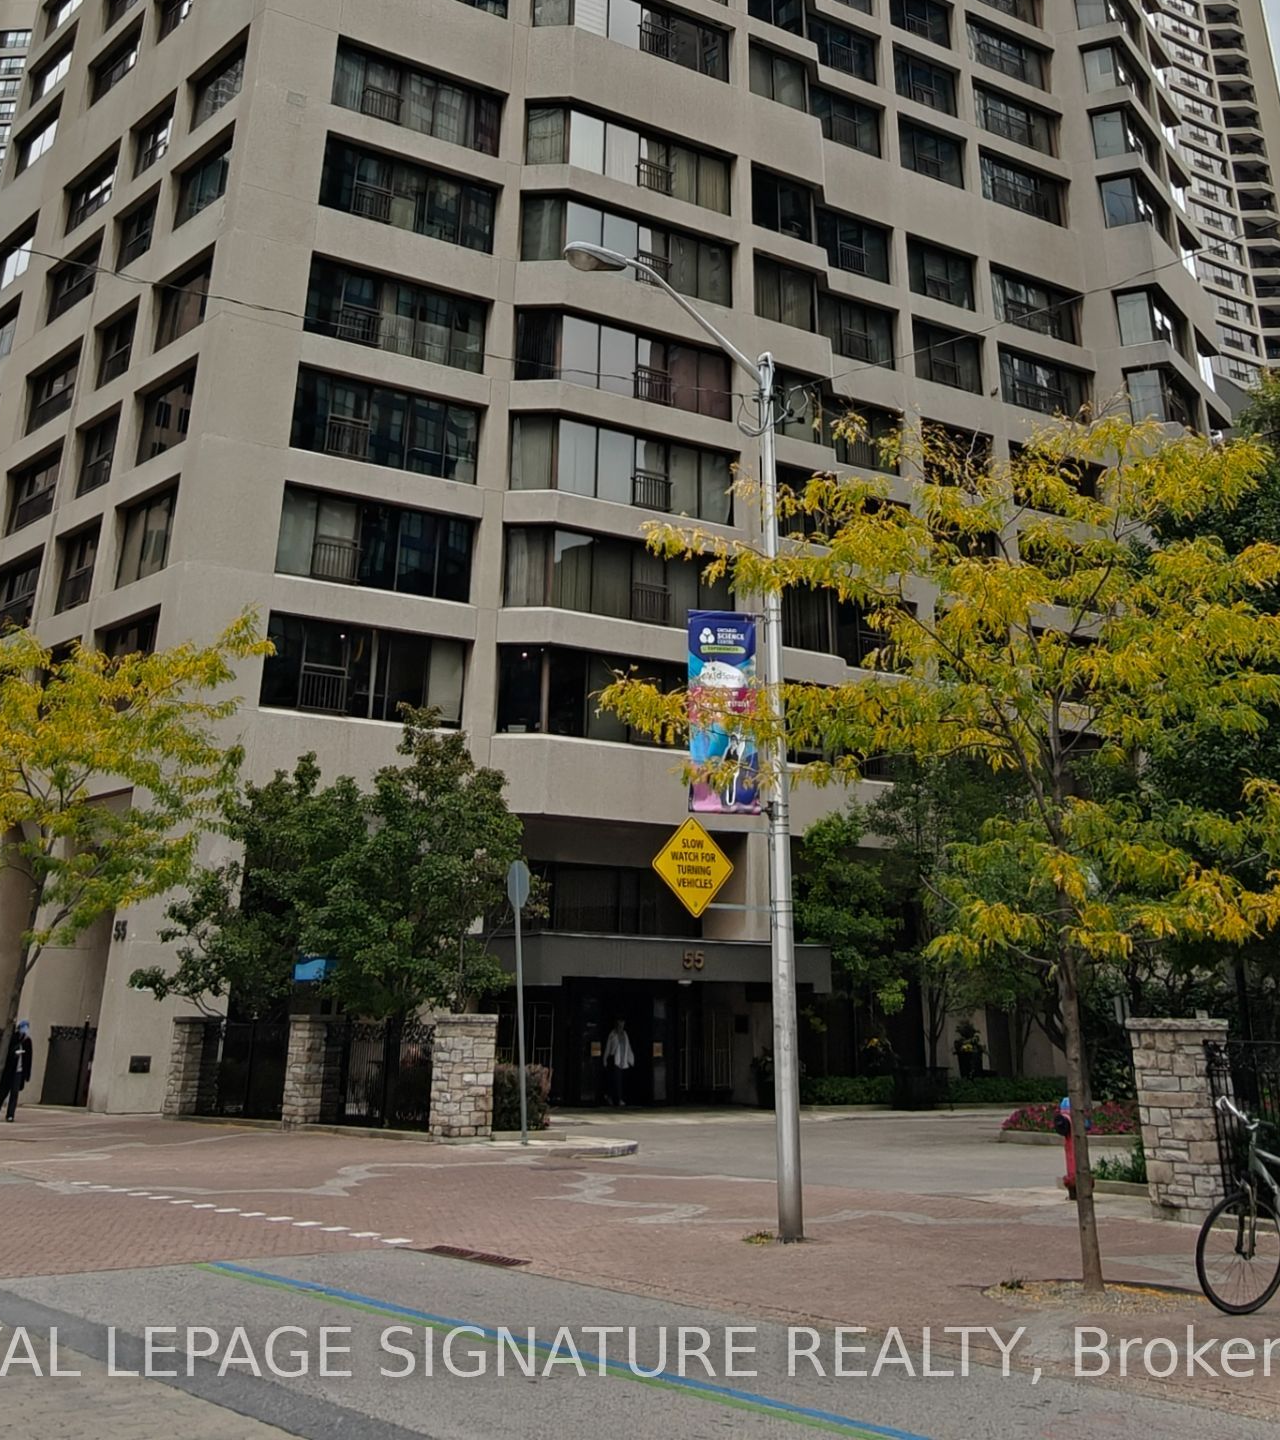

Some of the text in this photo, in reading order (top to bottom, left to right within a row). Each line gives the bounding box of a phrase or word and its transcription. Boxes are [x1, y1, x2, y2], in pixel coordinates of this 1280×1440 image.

[716, 633, 745, 641] SCIENCE
[681, 838, 705, 850] SLOW
[670, 851, 717, 863] WATCH FOR
[676, 864, 712, 876] TURNING
[676, 877, 714, 889] VEHICLES
[682, 950, 705, 970] 55
